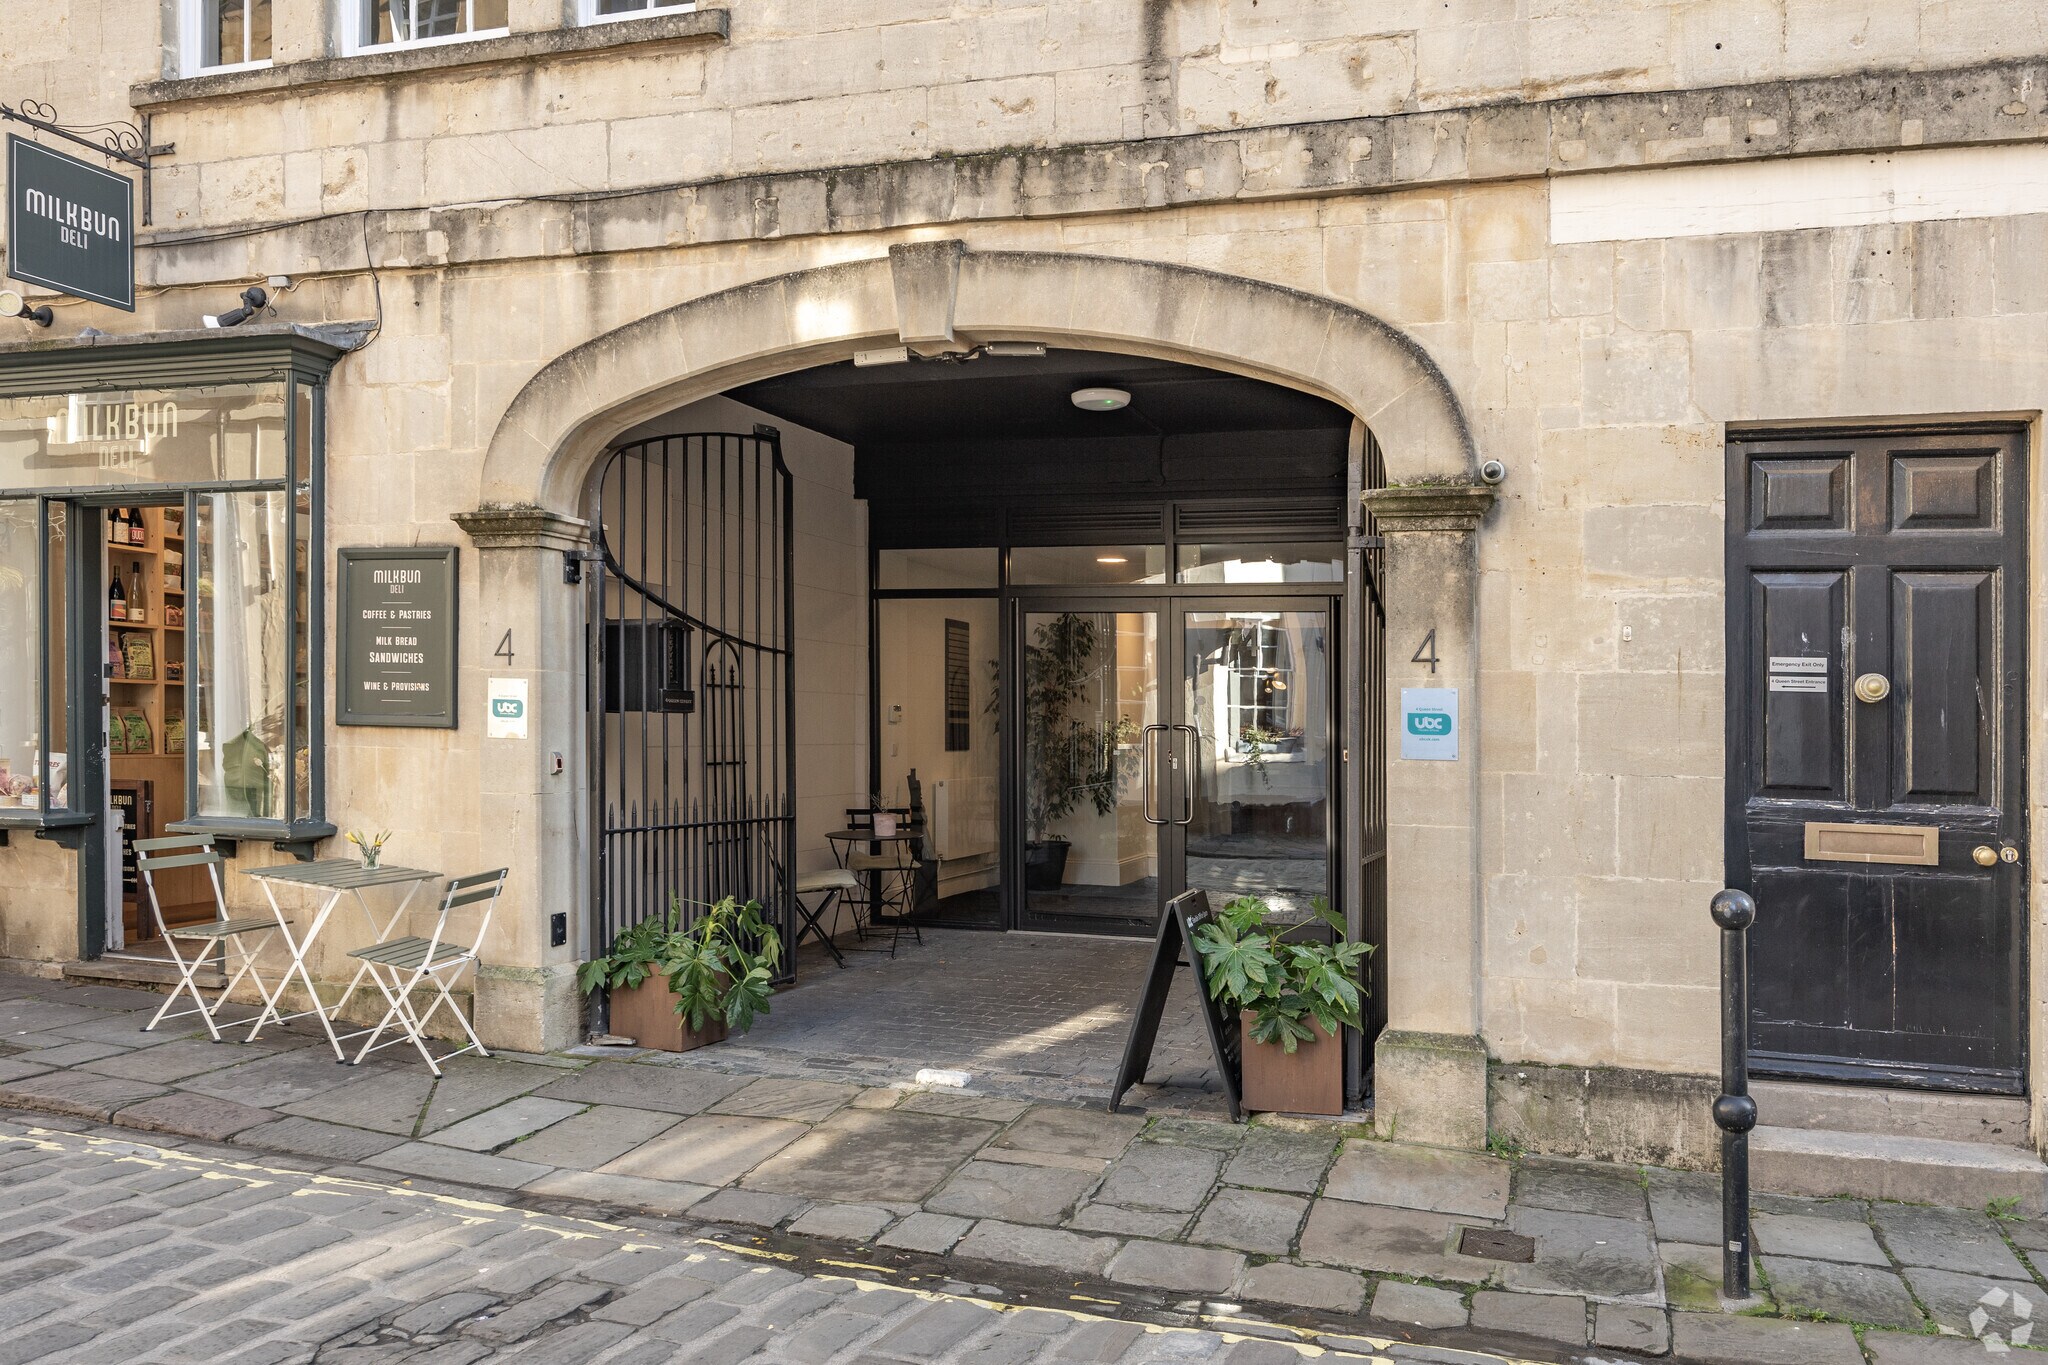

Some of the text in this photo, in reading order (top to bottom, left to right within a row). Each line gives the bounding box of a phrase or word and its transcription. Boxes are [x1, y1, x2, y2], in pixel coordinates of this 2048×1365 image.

[26, 188, 120, 242] MILKBUN
[61, 226, 88, 250] DELI
[99, 445, 134, 470] DELI
[373, 569, 421, 584] MILKBUN
[390, 584, 404, 594] DELI
[362, 609, 432, 620] COFFEE & PASTRIES
[376, 636, 417, 646] MILK BREAD
[494, 628, 515, 666] 4
[369, 651, 424, 664] SANDWICHES
[1411, 628, 1440, 673] 4
[363, 681, 430, 691] WINE & PROVISIONS
